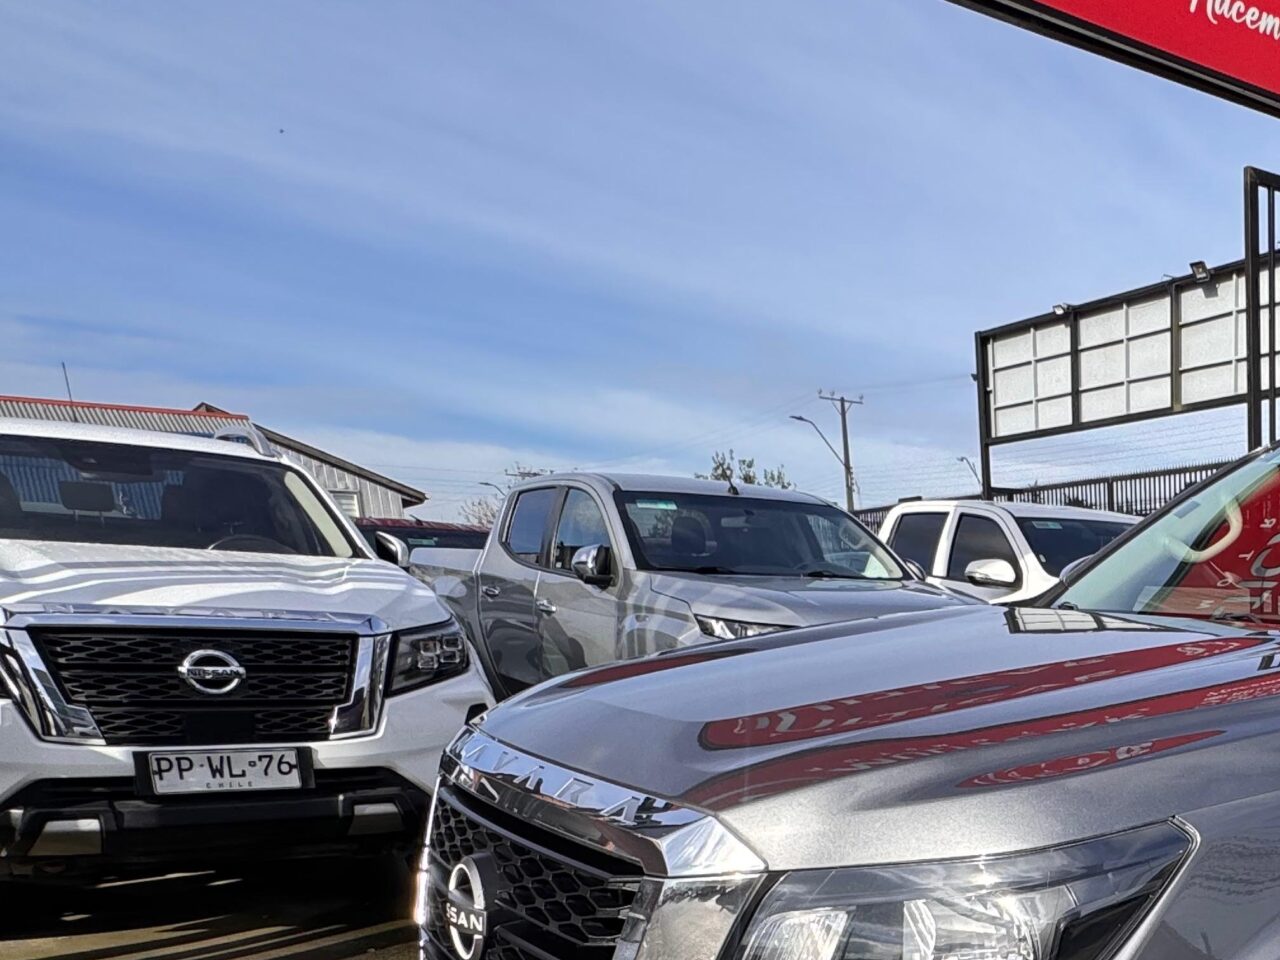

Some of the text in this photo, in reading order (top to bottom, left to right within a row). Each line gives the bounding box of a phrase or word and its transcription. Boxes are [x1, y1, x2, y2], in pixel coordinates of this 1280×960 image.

[186, 667, 241, 678] NISSAN
[206, 781, 253, 789] CHILE
[446, 903, 483, 932] SAN
